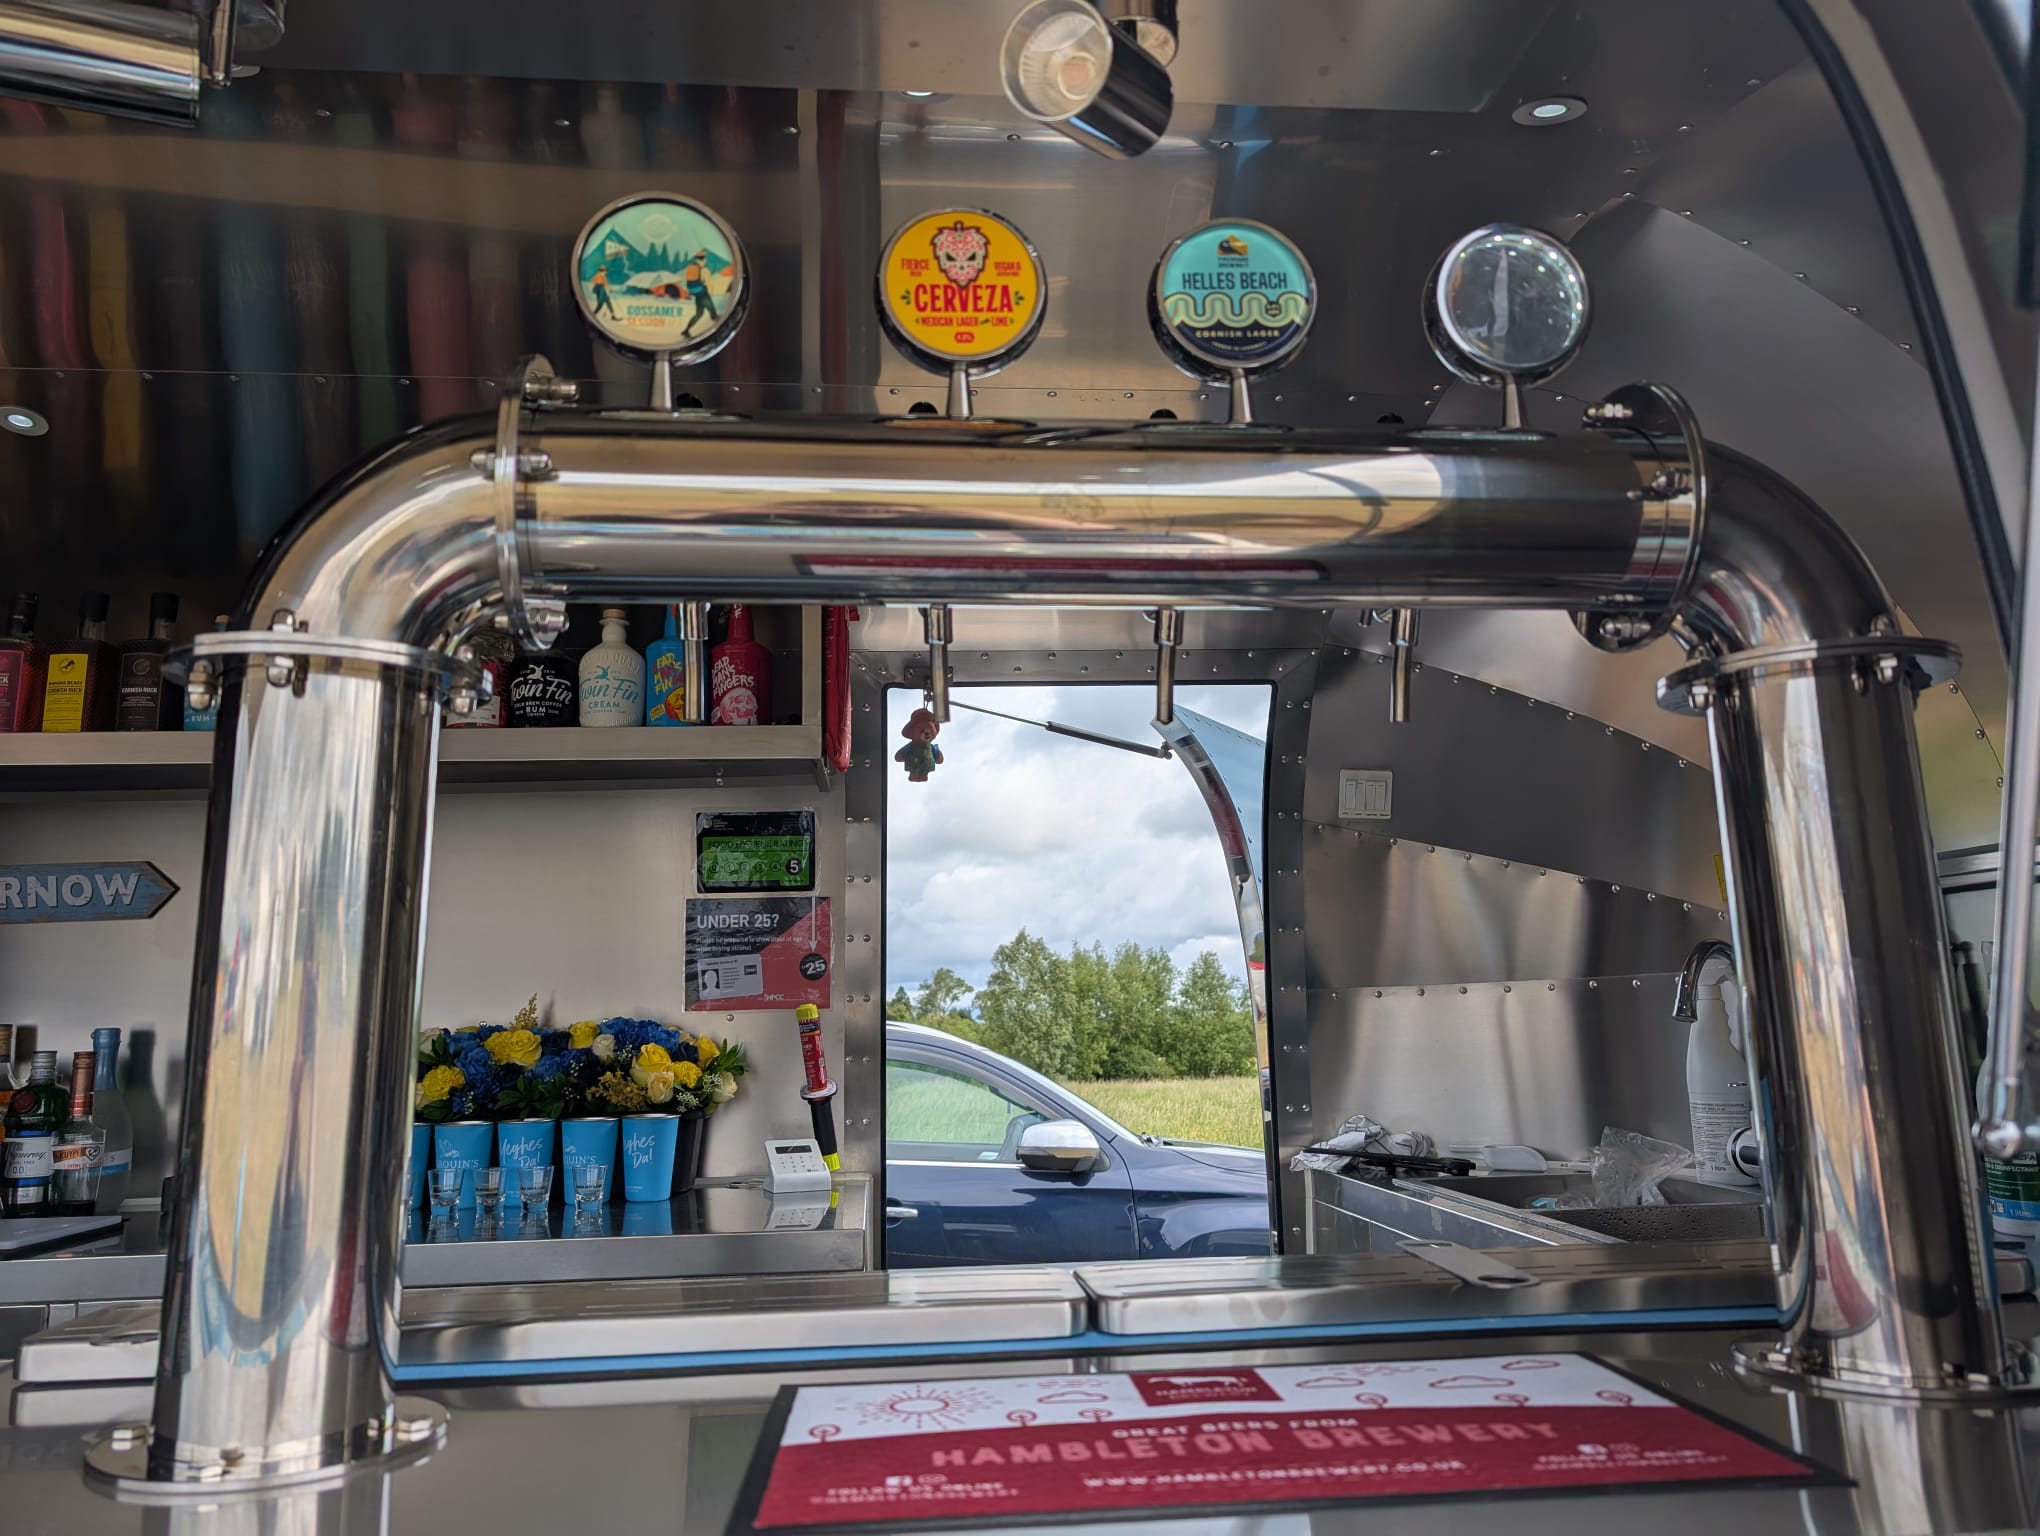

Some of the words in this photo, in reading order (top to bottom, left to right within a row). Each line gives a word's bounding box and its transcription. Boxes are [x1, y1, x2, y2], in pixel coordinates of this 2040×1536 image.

[901, 258, 929, 271] FIERCE
[1182, 272, 1236, 291] HELLES
[1239, 272, 1288, 290] BEACH
[914, 283, 1014, 313] CERVEZA
[626, 304, 684, 317] GOSSAMER
[627, 317, 666, 328] SESSION
[920, 316, 954, 327] MEXICAN
[956, 316, 978, 327] LAGER
[1195, 329, 1243, 339] CORNISH
[1246, 329, 1280, 338] LAGER
[711, 655, 730, 676] DEAD
[510, 677, 544, 703] Twin
[546, 675, 573, 705] Fin
[580, 678, 610, 704] Twin
[612, 676, 639, 704] Fin
[712, 674, 754, 699] FINGERS
[525, 705, 546, 713] RUM
[588, 701, 621, 709] CREAM
[708, 839, 733, 849] FOOD
[789, 860, 799, 873] 5
[697, 914, 750, 929] UNDER
[754, 913, 779, 928] 25?
[805, 960, 826, 976] 25
[1995, 1164, 2040, 1173] DISINFECTANT
[1112, 1424, 1188, 1438] GREAT
[1200, 1418, 1280, 1432] BEERS
[1288, 1417, 1359, 1429] FROM
[932, 1431, 1272, 1467] HAMBLETON
[1292, 1422, 1559, 1450] BREWERY
